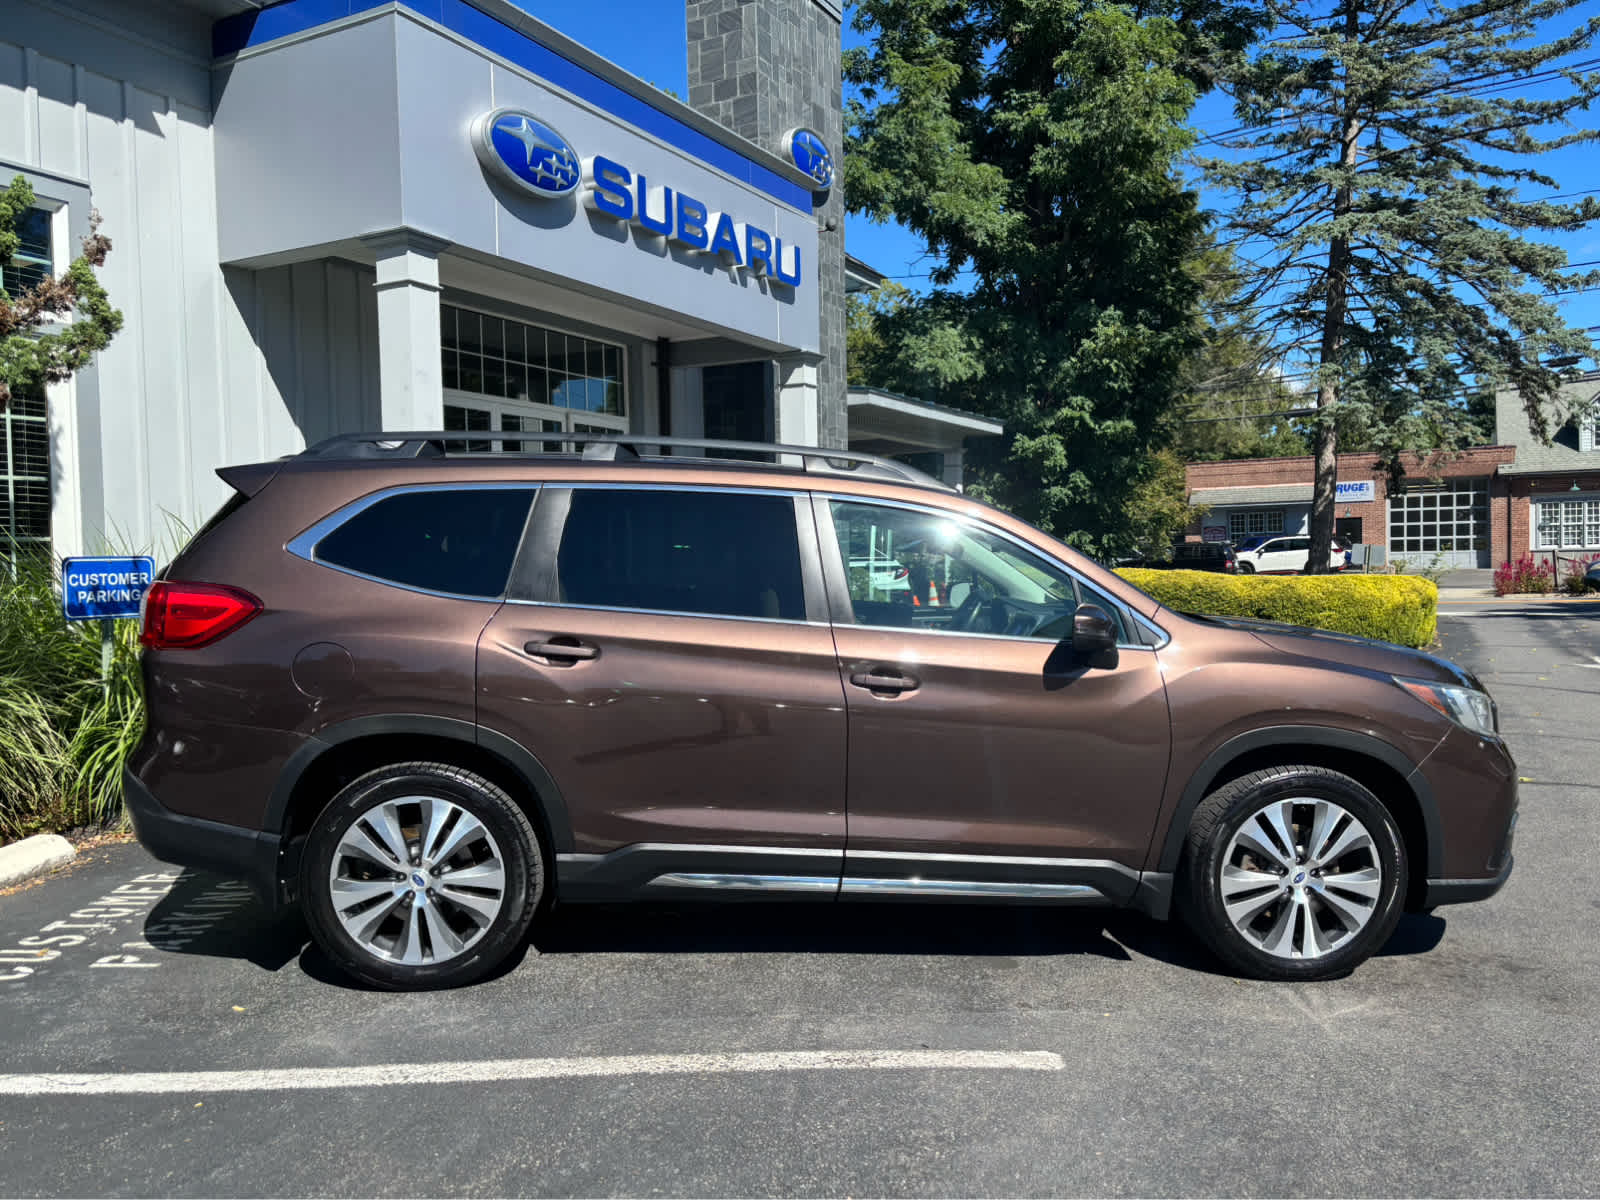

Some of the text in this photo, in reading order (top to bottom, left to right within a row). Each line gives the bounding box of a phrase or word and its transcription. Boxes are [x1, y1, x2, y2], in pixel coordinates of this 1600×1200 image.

[592, 155, 800, 288] SUBARU
[68, 572, 149, 587] CUSTOMER
[78, 589, 140, 603] PARKING
